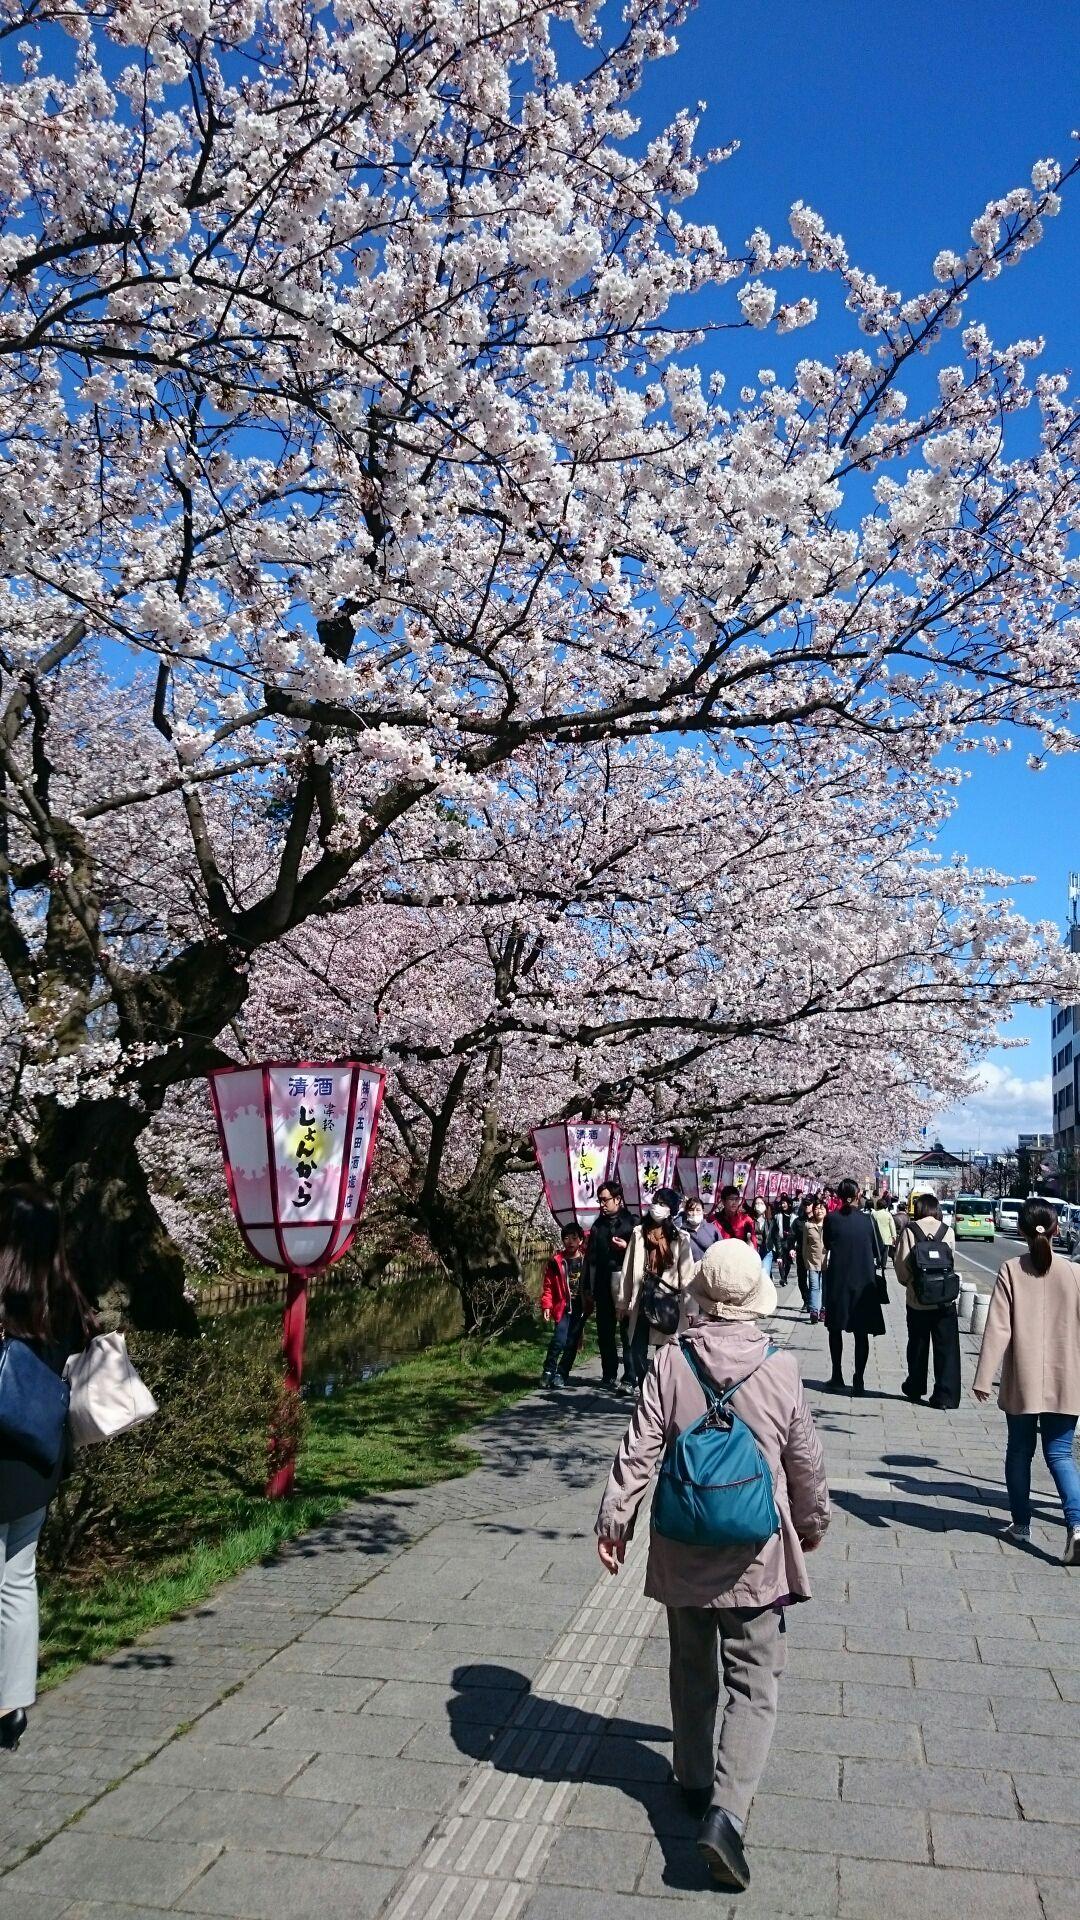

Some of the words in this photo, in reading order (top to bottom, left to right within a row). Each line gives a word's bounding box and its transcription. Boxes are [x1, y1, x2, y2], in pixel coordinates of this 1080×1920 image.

[288, 1077, 333, 1097] 清酒
[291, 1105, 317, 1208] じょんから
